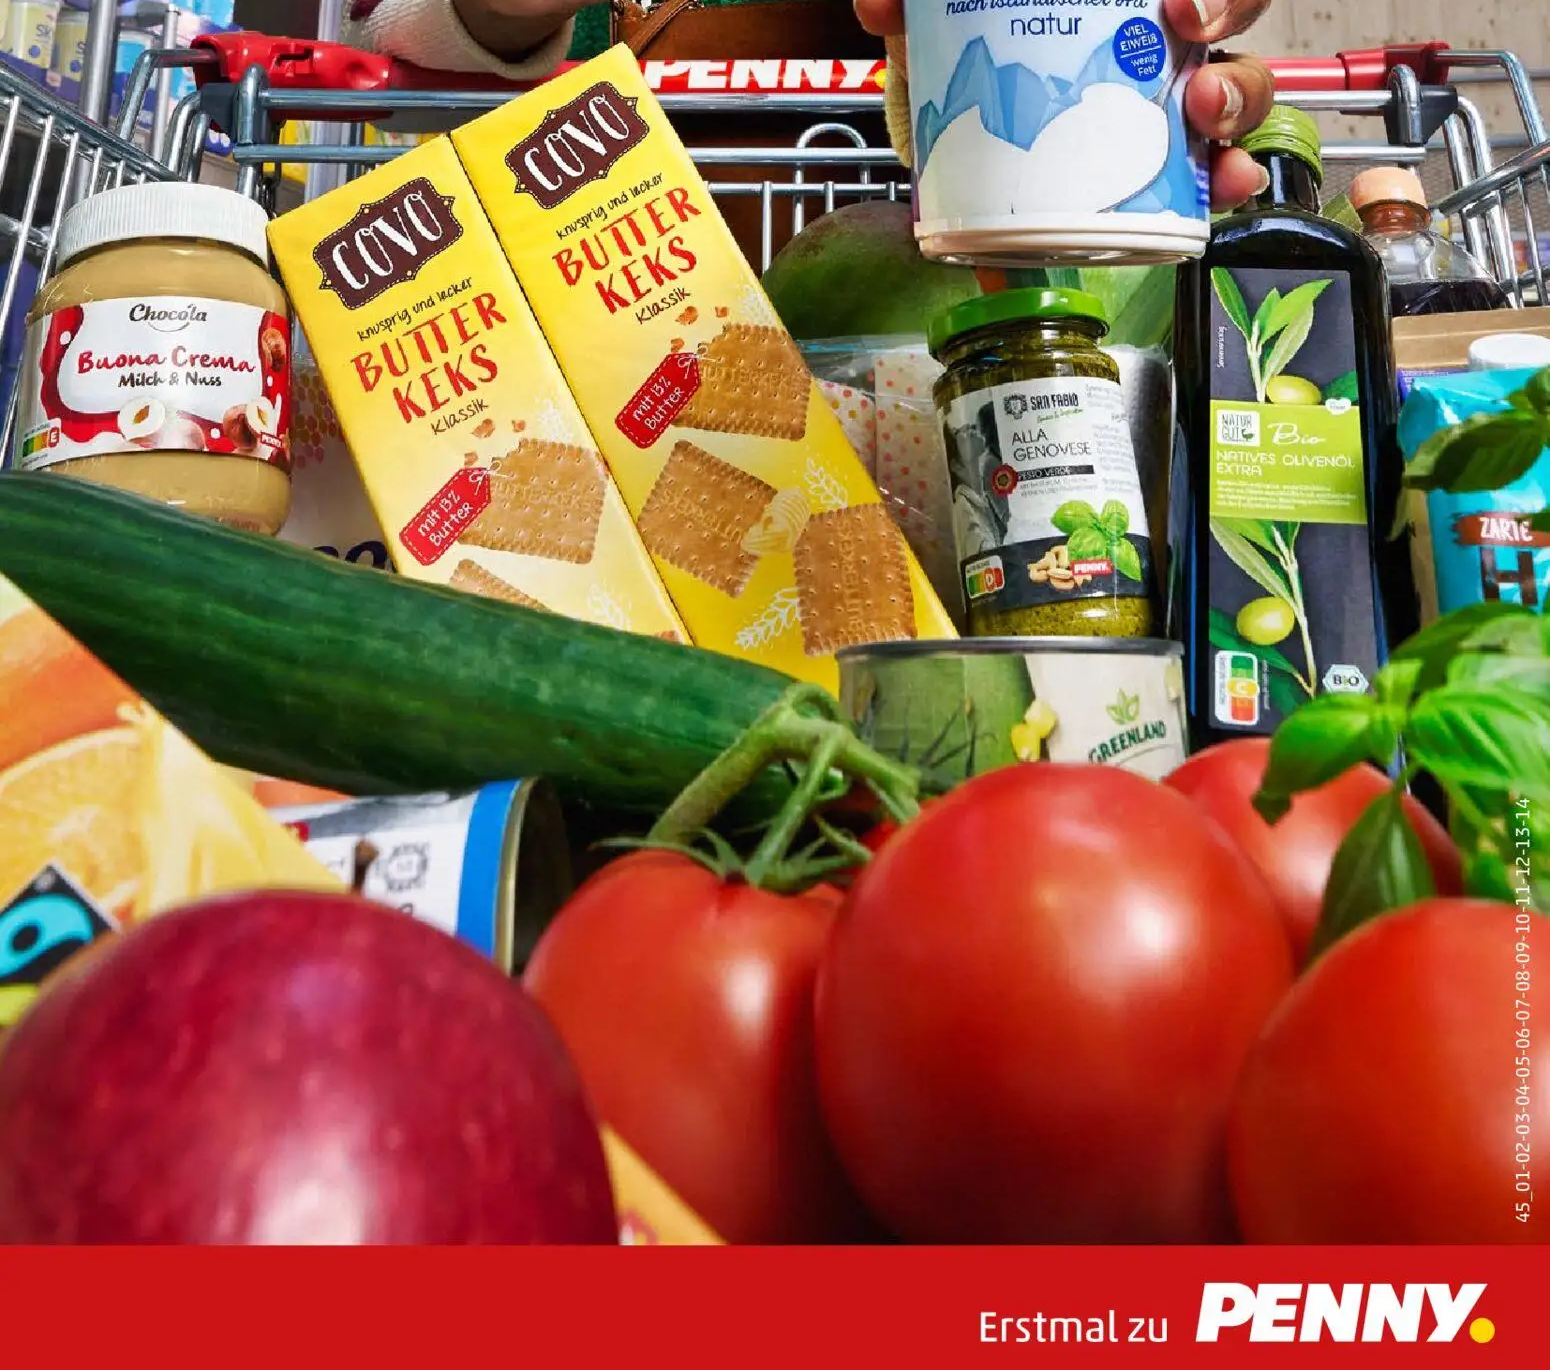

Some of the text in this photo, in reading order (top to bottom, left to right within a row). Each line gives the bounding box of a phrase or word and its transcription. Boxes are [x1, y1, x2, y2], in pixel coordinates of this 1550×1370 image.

[1011, 12, 1082, 35] natur
[1124, 24, 1149, 37] VIEL
[1131, 53, 1158, 67] wenig
[1138, 65, 1157, 77] Fett
[524, 94, 629, 191] COVO
[556, 173, 664, 240] knusprig und lecker
[332, 190, 442, 290] COVO
[552, 187, 701, 286] BUTTER
[595, 235, 697, 314] KEKS
[357, 276, 473, 341] knusprig und lecker
[635, 286, 691, 325] Klassik
[350, 292, 507, 392] BUTTER
[77, 345, 256, 374] Buona Crema
[118, 371, 222, 387] Milch & Nuss
[392, 343, 498, 424] KEKS
[431, 397, 490, 435] Klassik
[632, 395, 653, 422] mit
[644, 386, 685, 431] Butter
[1030, 395, 1049, 410] SAN
[1052, 393, 1079, 408] FABIO
[1222, 414, 1252, 428] NATUR
[1267, 422, 1327, 445] Bio
[1011, 428, 1048, 446] ALLA
[1013, 441, 1093, 462] GENOVESE
[1216, 450, 1355, 469] NATIVES OLIVENÖL
[1216, 464, 1262, 477] EXTRA
[418, 508, 442, 537] mit
[428, 502, 474, 547] Butter
[1088, 720, 1167, 764] GREENLAND
